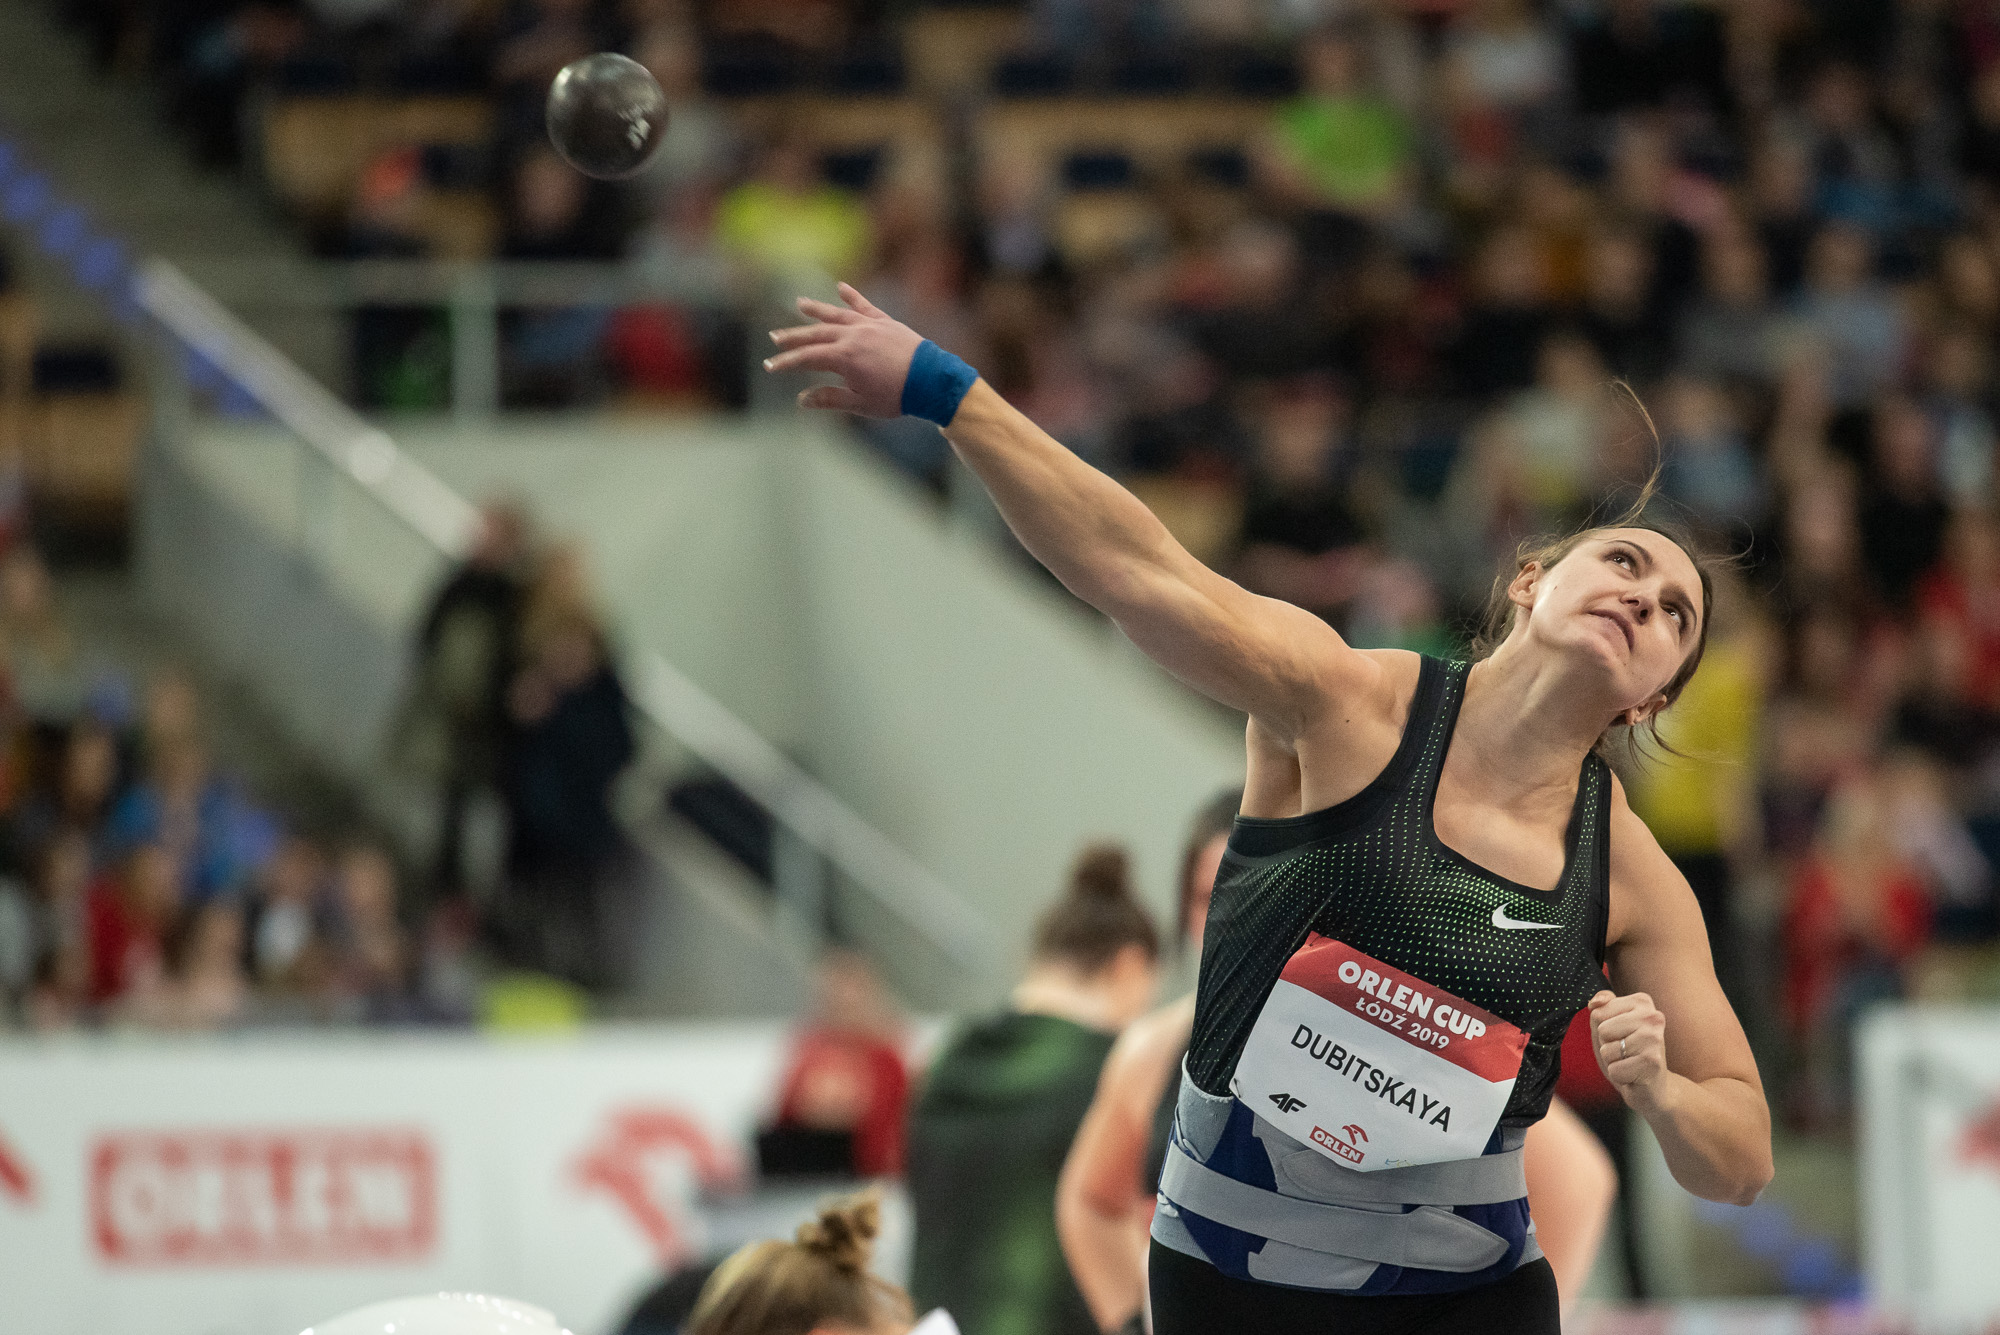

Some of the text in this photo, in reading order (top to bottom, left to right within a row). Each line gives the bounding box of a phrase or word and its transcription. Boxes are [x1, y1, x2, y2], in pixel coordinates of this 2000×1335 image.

[1338, 961, 1487, 1041] ORLEN CUP
[1355, 997, 1450, 1050] ŁÓDŹ 2019
[1268, 1092, 1307, 1114] 4F
[1290, 1024, 1451, 1133] DUBITSKAYA
[1313, 1130, 1361, 1162] ORLEN
